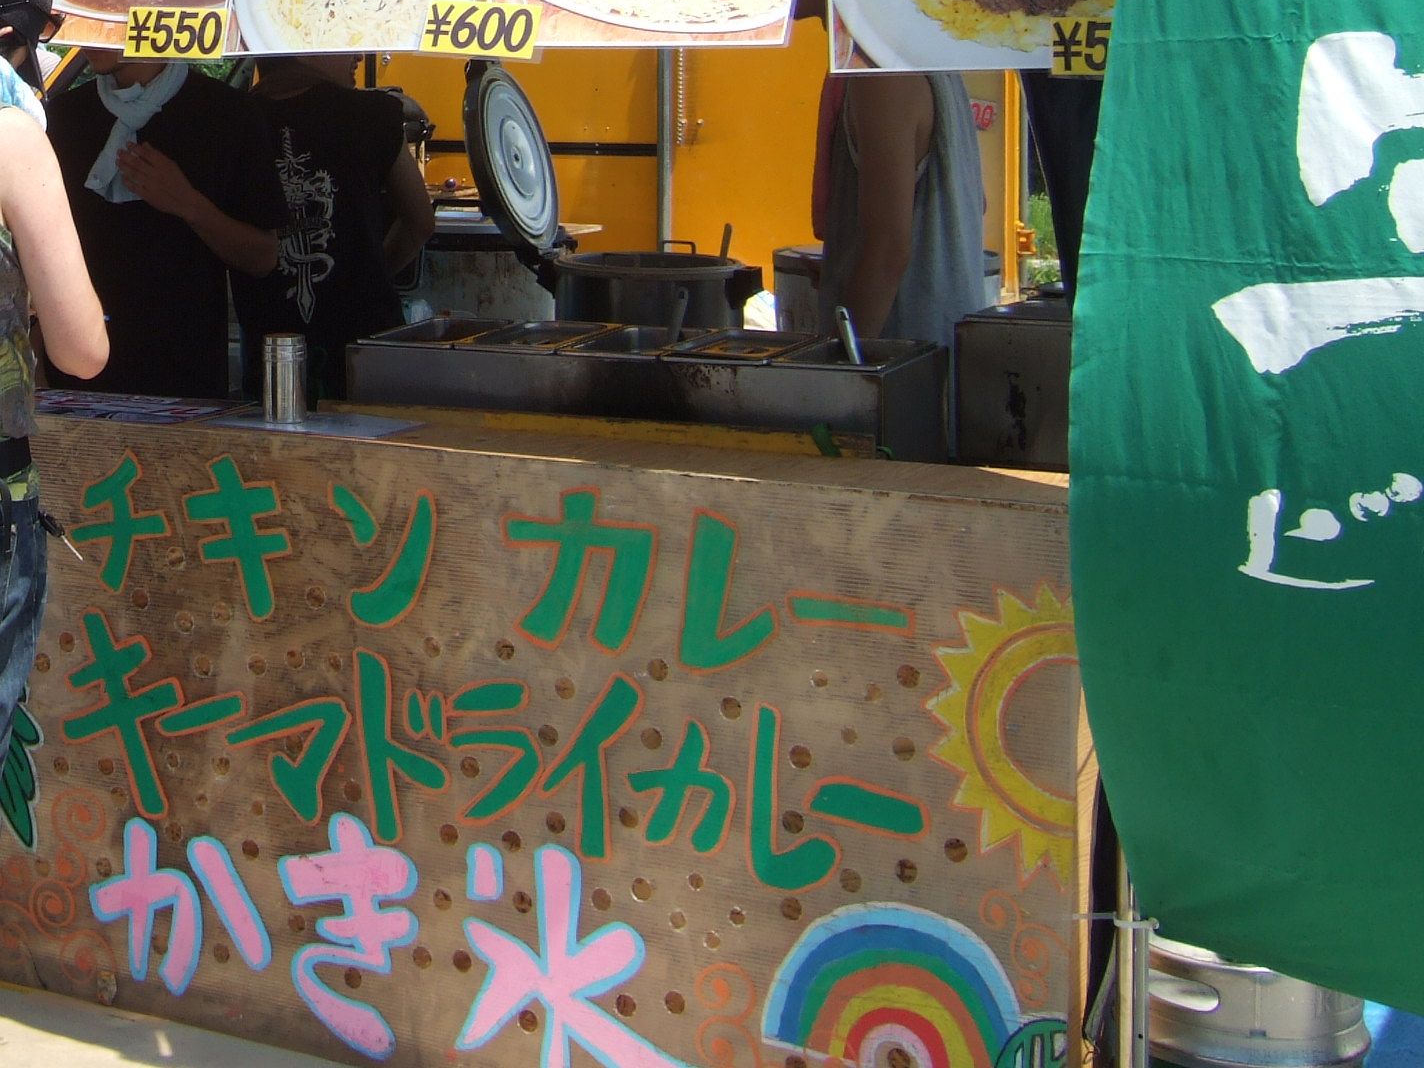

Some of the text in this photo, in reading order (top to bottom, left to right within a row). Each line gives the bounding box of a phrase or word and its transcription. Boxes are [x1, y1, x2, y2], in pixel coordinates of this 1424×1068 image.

[128, 10, 223, 55] ¥550
[425, 3, 534, 52] ¥600
[1052, 20, 1112, 72] ¥5
[89, 811, 693, 1068] かき氷
